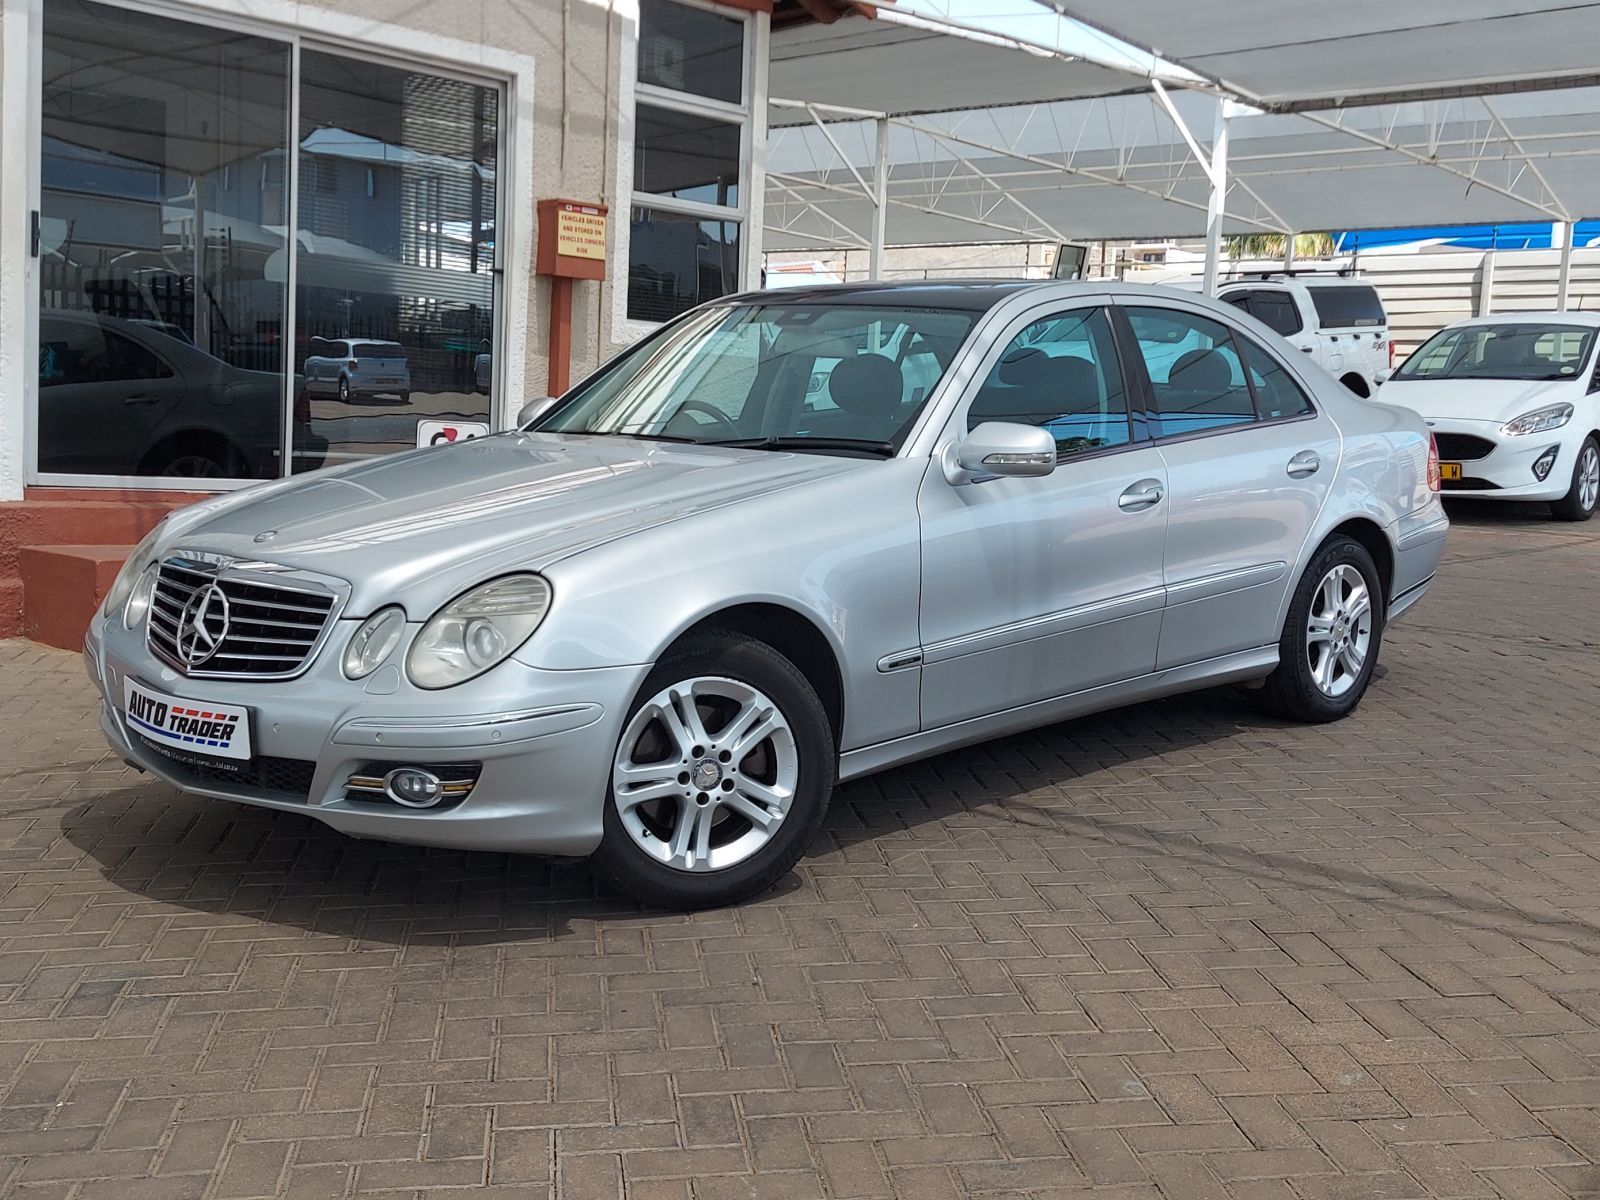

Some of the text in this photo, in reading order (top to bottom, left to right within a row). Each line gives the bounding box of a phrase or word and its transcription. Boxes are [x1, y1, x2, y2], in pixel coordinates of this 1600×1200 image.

[561, 215, 604, 226] VEHICLES DRIVEN
[575, 226, 593, 235] STORED
[560, 235, 604, 246] VEHICLES OWNERS
[1452, 466, 1458, 477] W
[129, 690, 236, 741] AUTO TRADER
